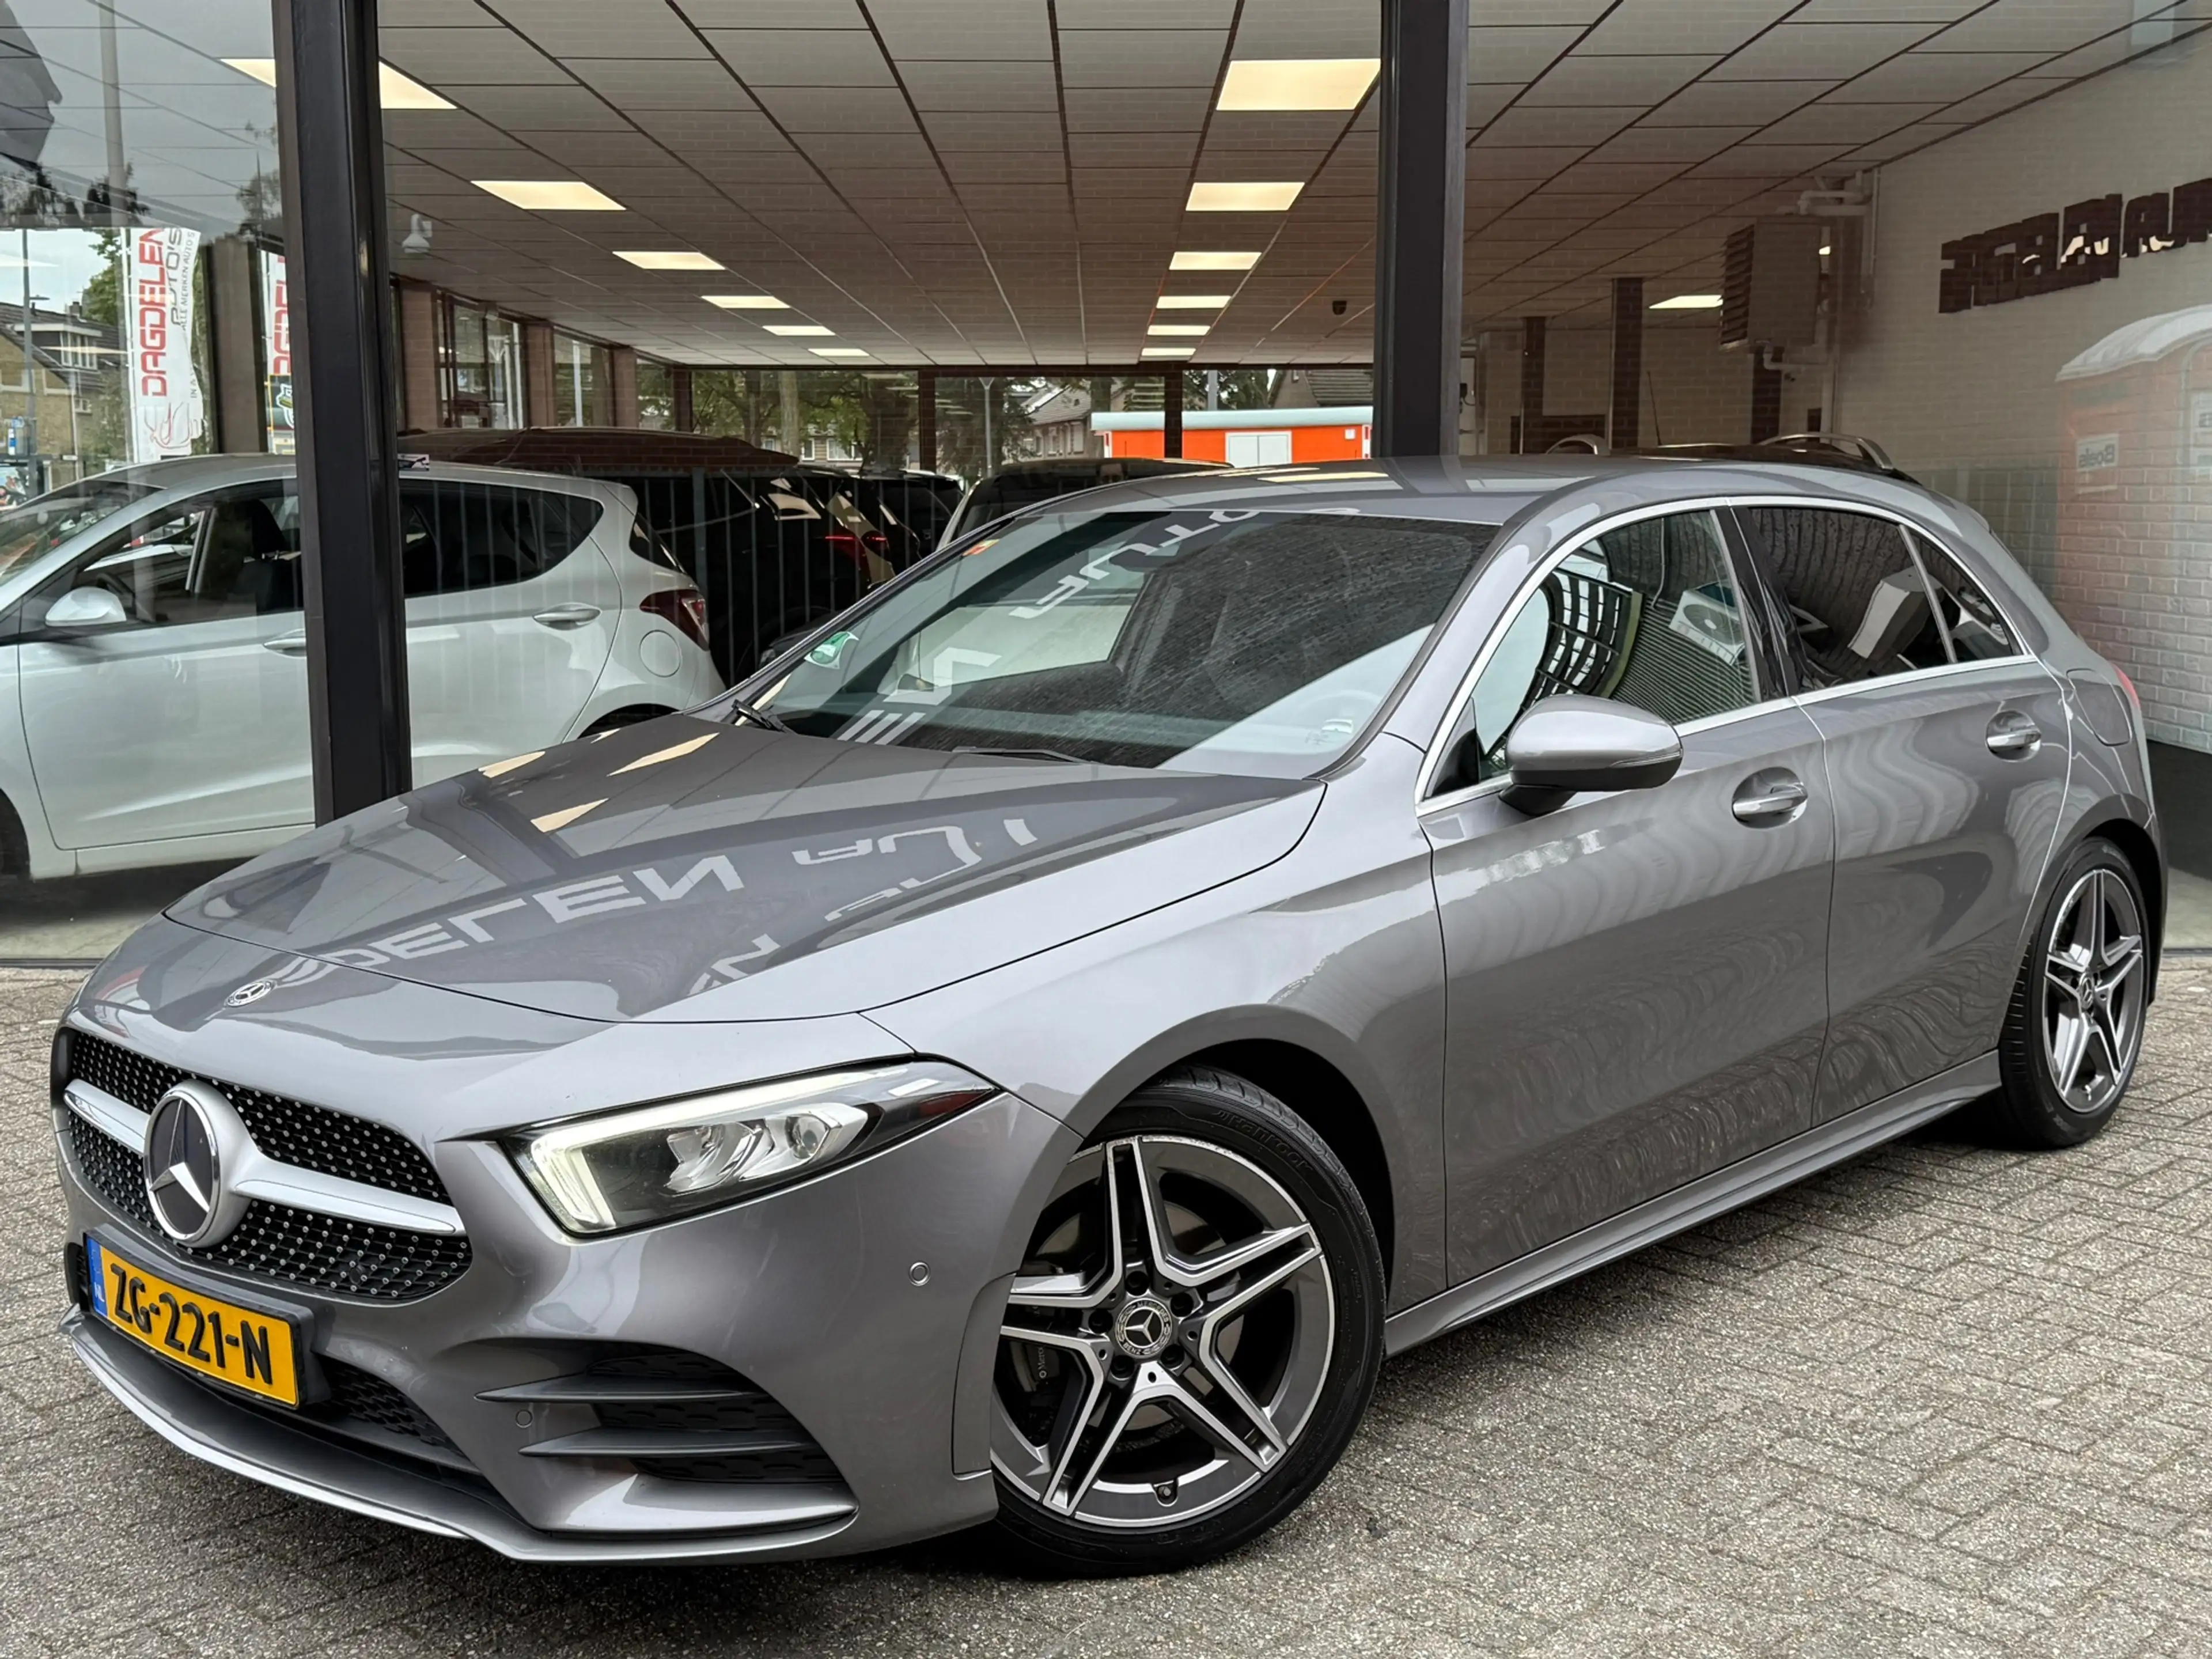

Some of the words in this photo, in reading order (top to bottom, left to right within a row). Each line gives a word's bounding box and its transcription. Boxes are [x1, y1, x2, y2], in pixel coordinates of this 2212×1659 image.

[138, 228, 167, 397] DAGDELEN
[94, 1282, 105, 1302] NL
[111, 1263, 272, 1385] ZG-221-N
